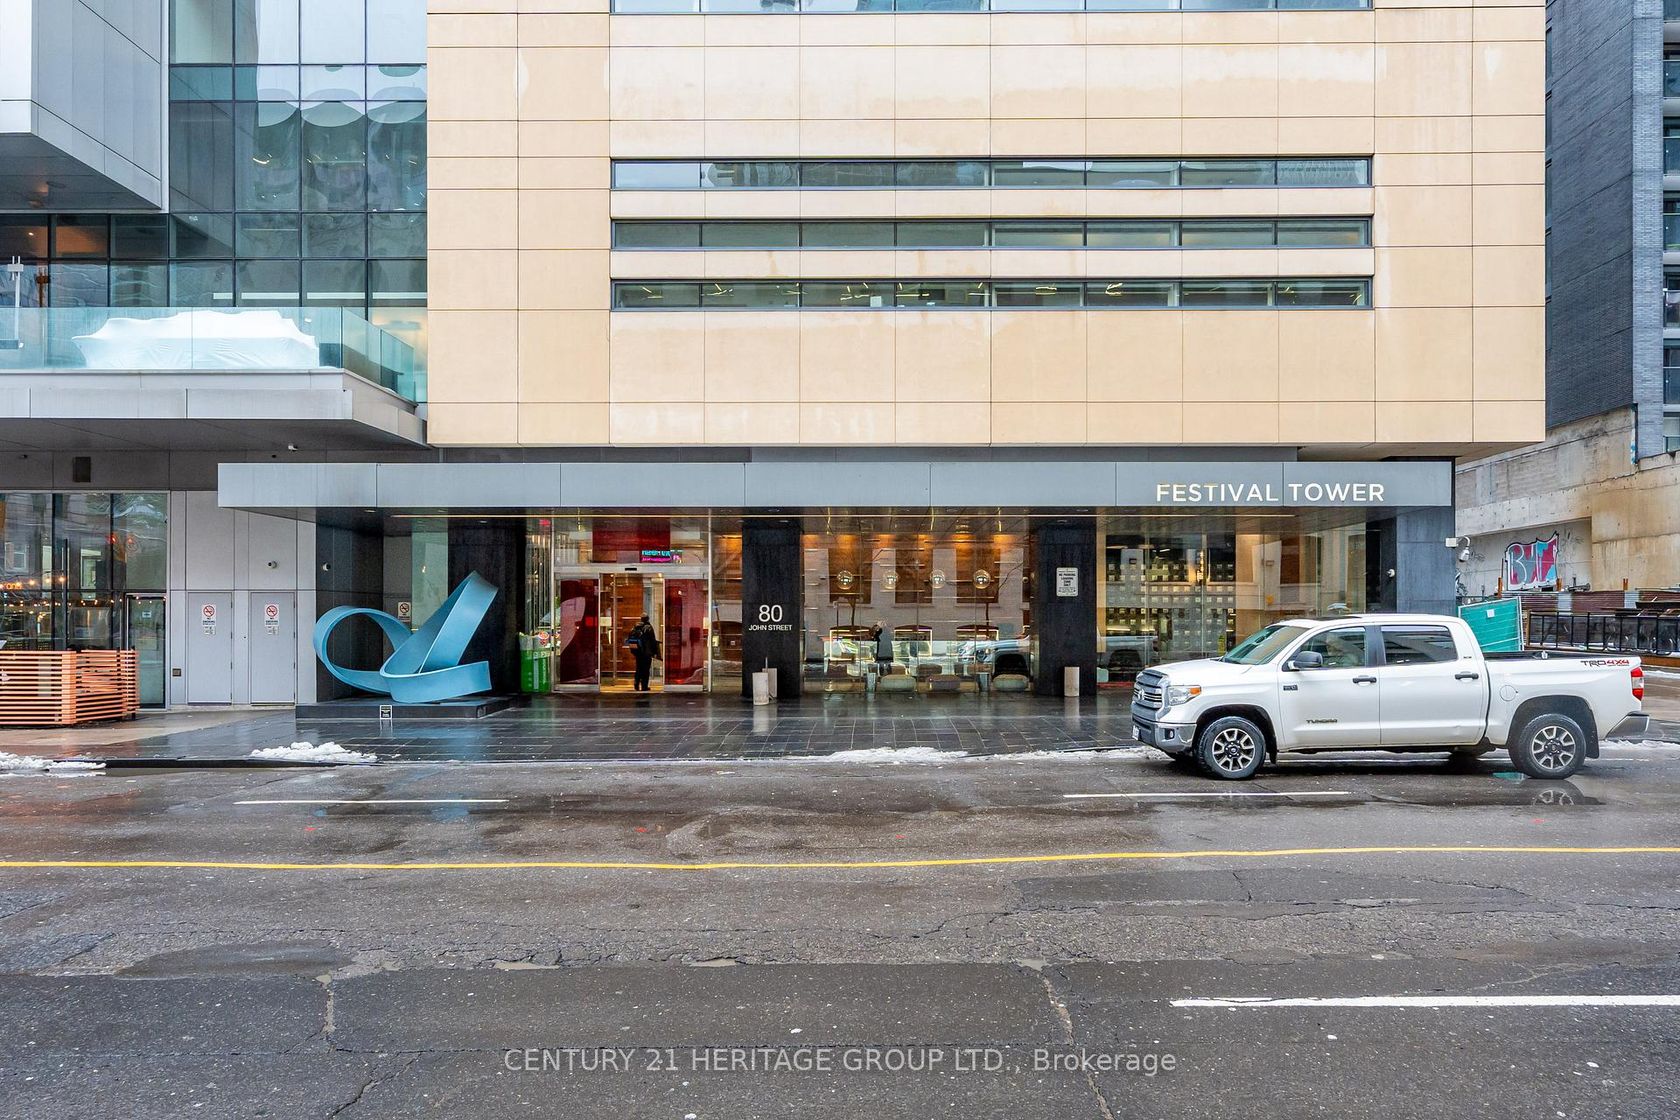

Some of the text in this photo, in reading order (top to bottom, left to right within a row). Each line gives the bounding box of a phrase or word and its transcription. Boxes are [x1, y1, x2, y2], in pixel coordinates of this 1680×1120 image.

[1156, 483, 1385, 502] FESTIVAL TOWER
[758, 604, 783, 622] 80
